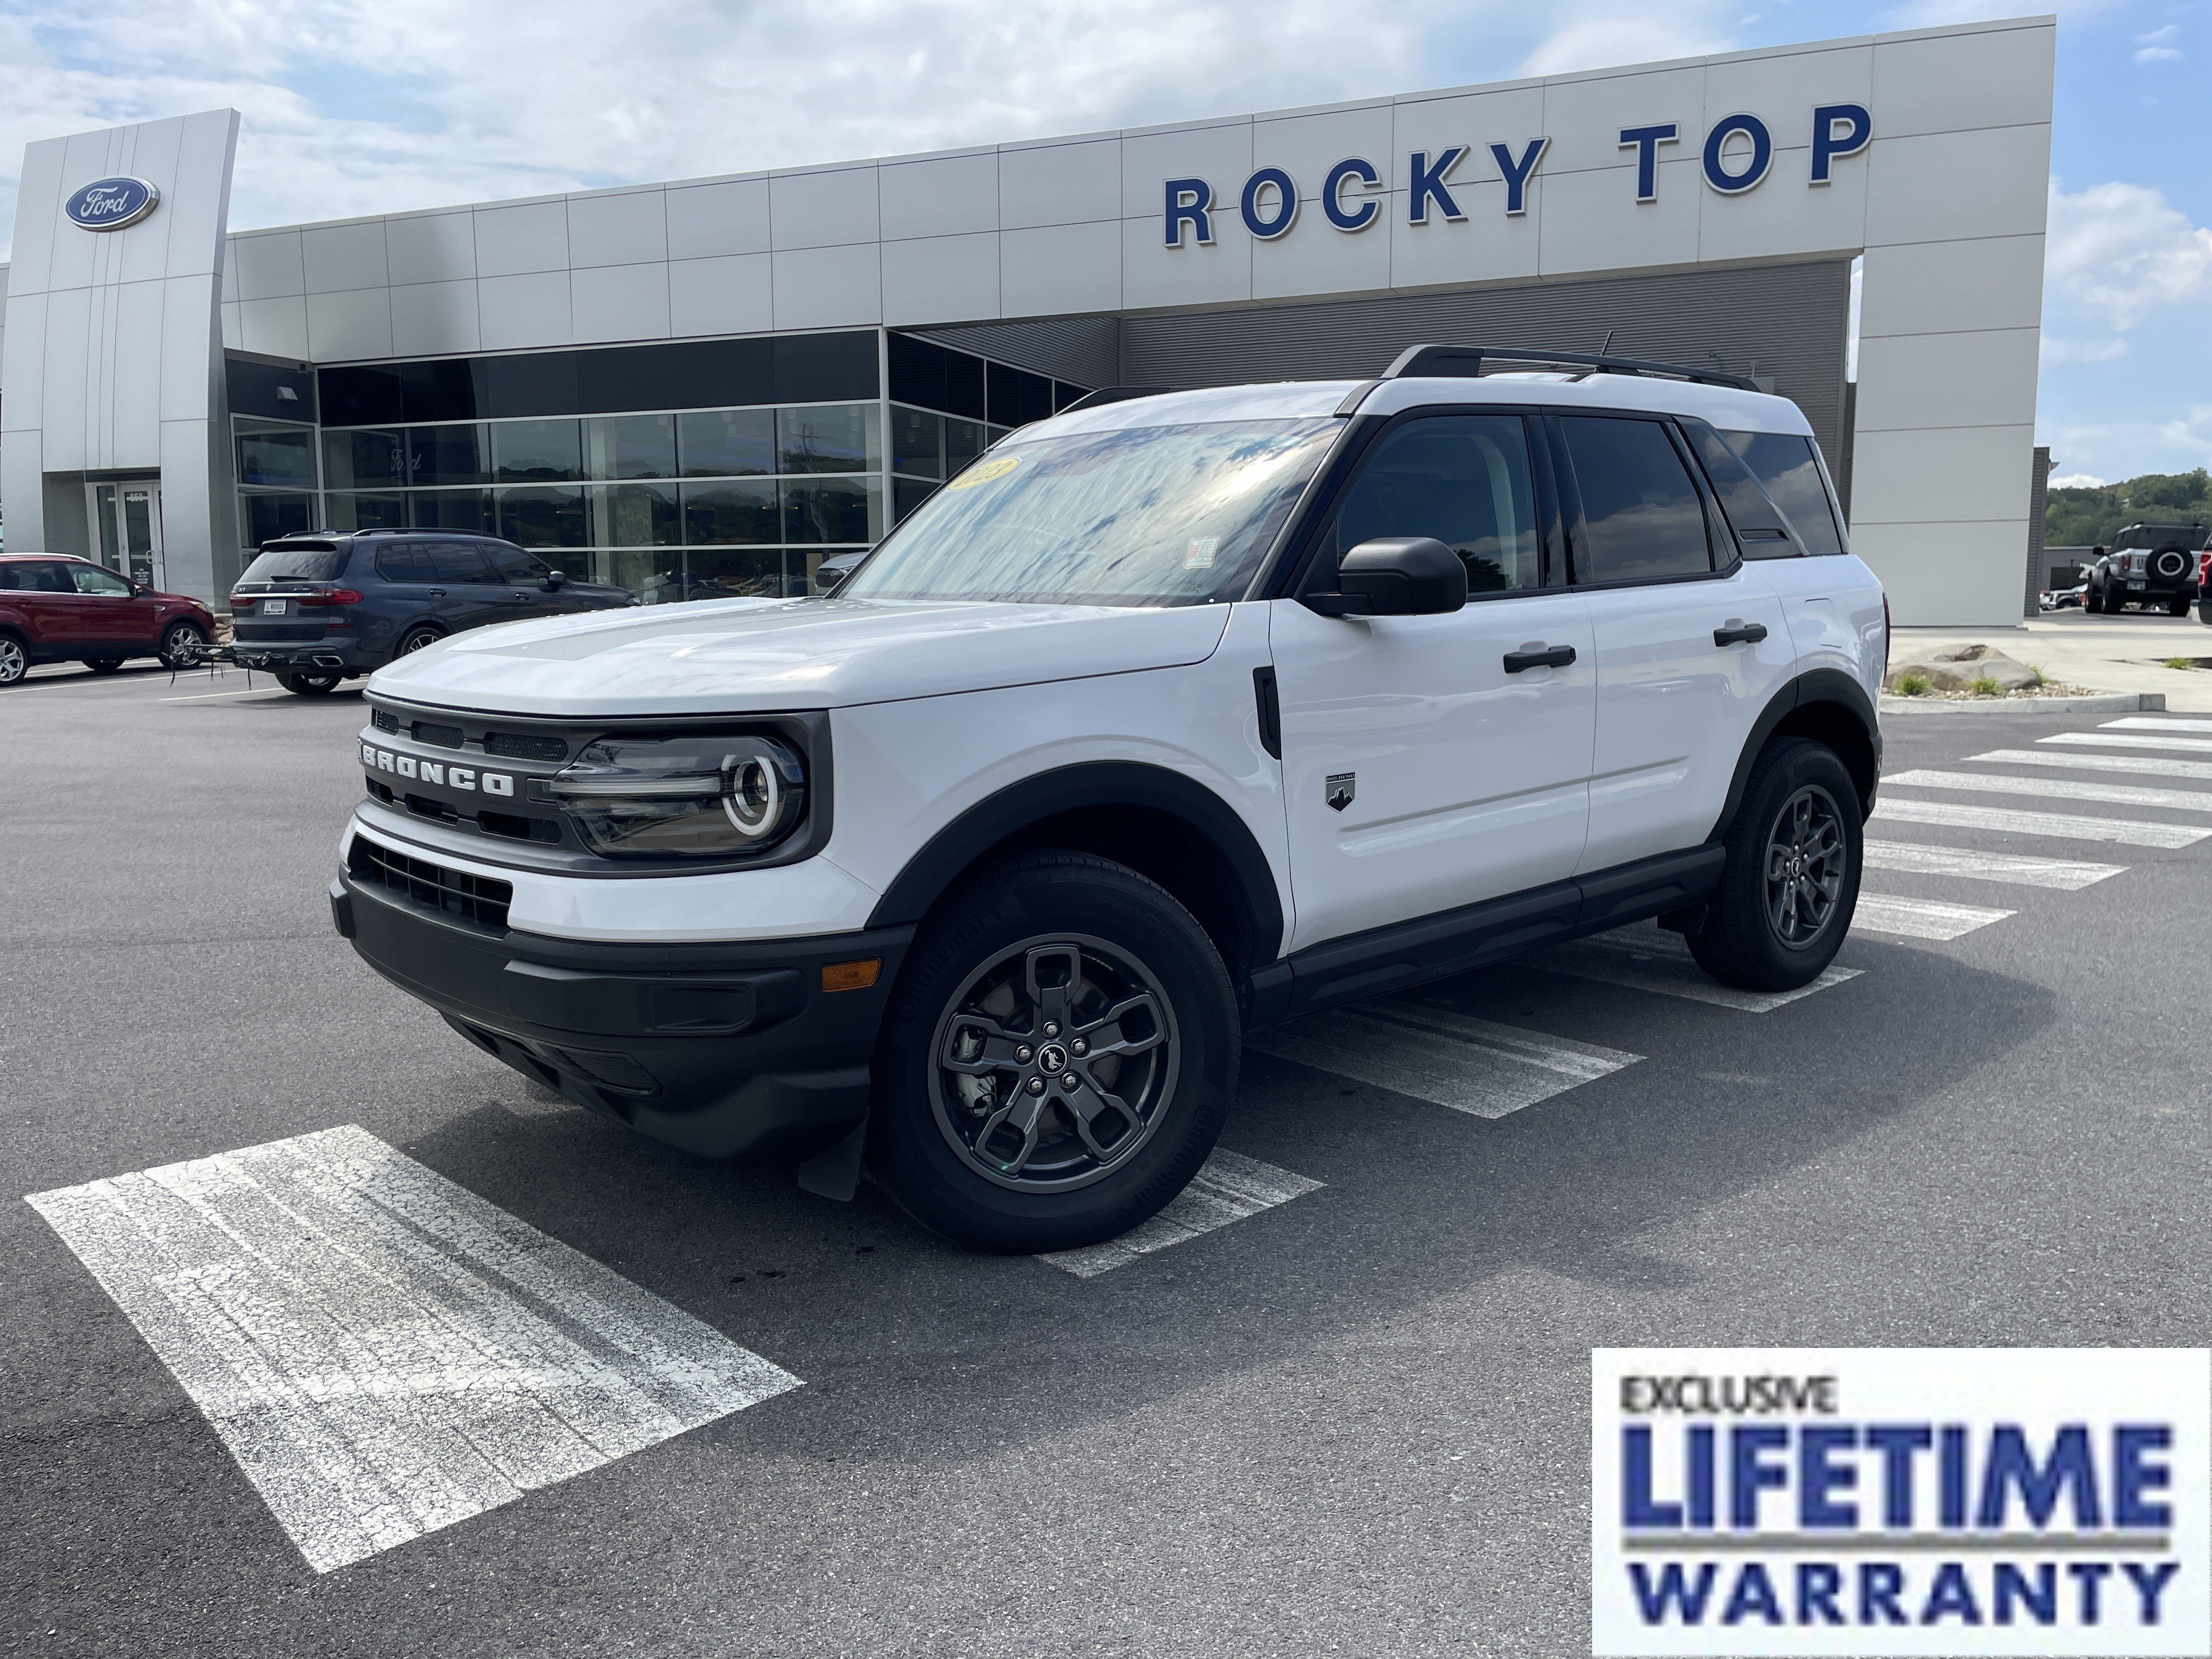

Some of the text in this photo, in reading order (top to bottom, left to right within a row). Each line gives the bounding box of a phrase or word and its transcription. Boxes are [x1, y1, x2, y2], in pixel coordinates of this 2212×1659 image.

[1163, 102, 1874, 247] ROCKY TOP
[81, 187, 129, 217] Ford
[391, 449, 422, 472] Fod
[363, 745, 514, 797] BRONCO
